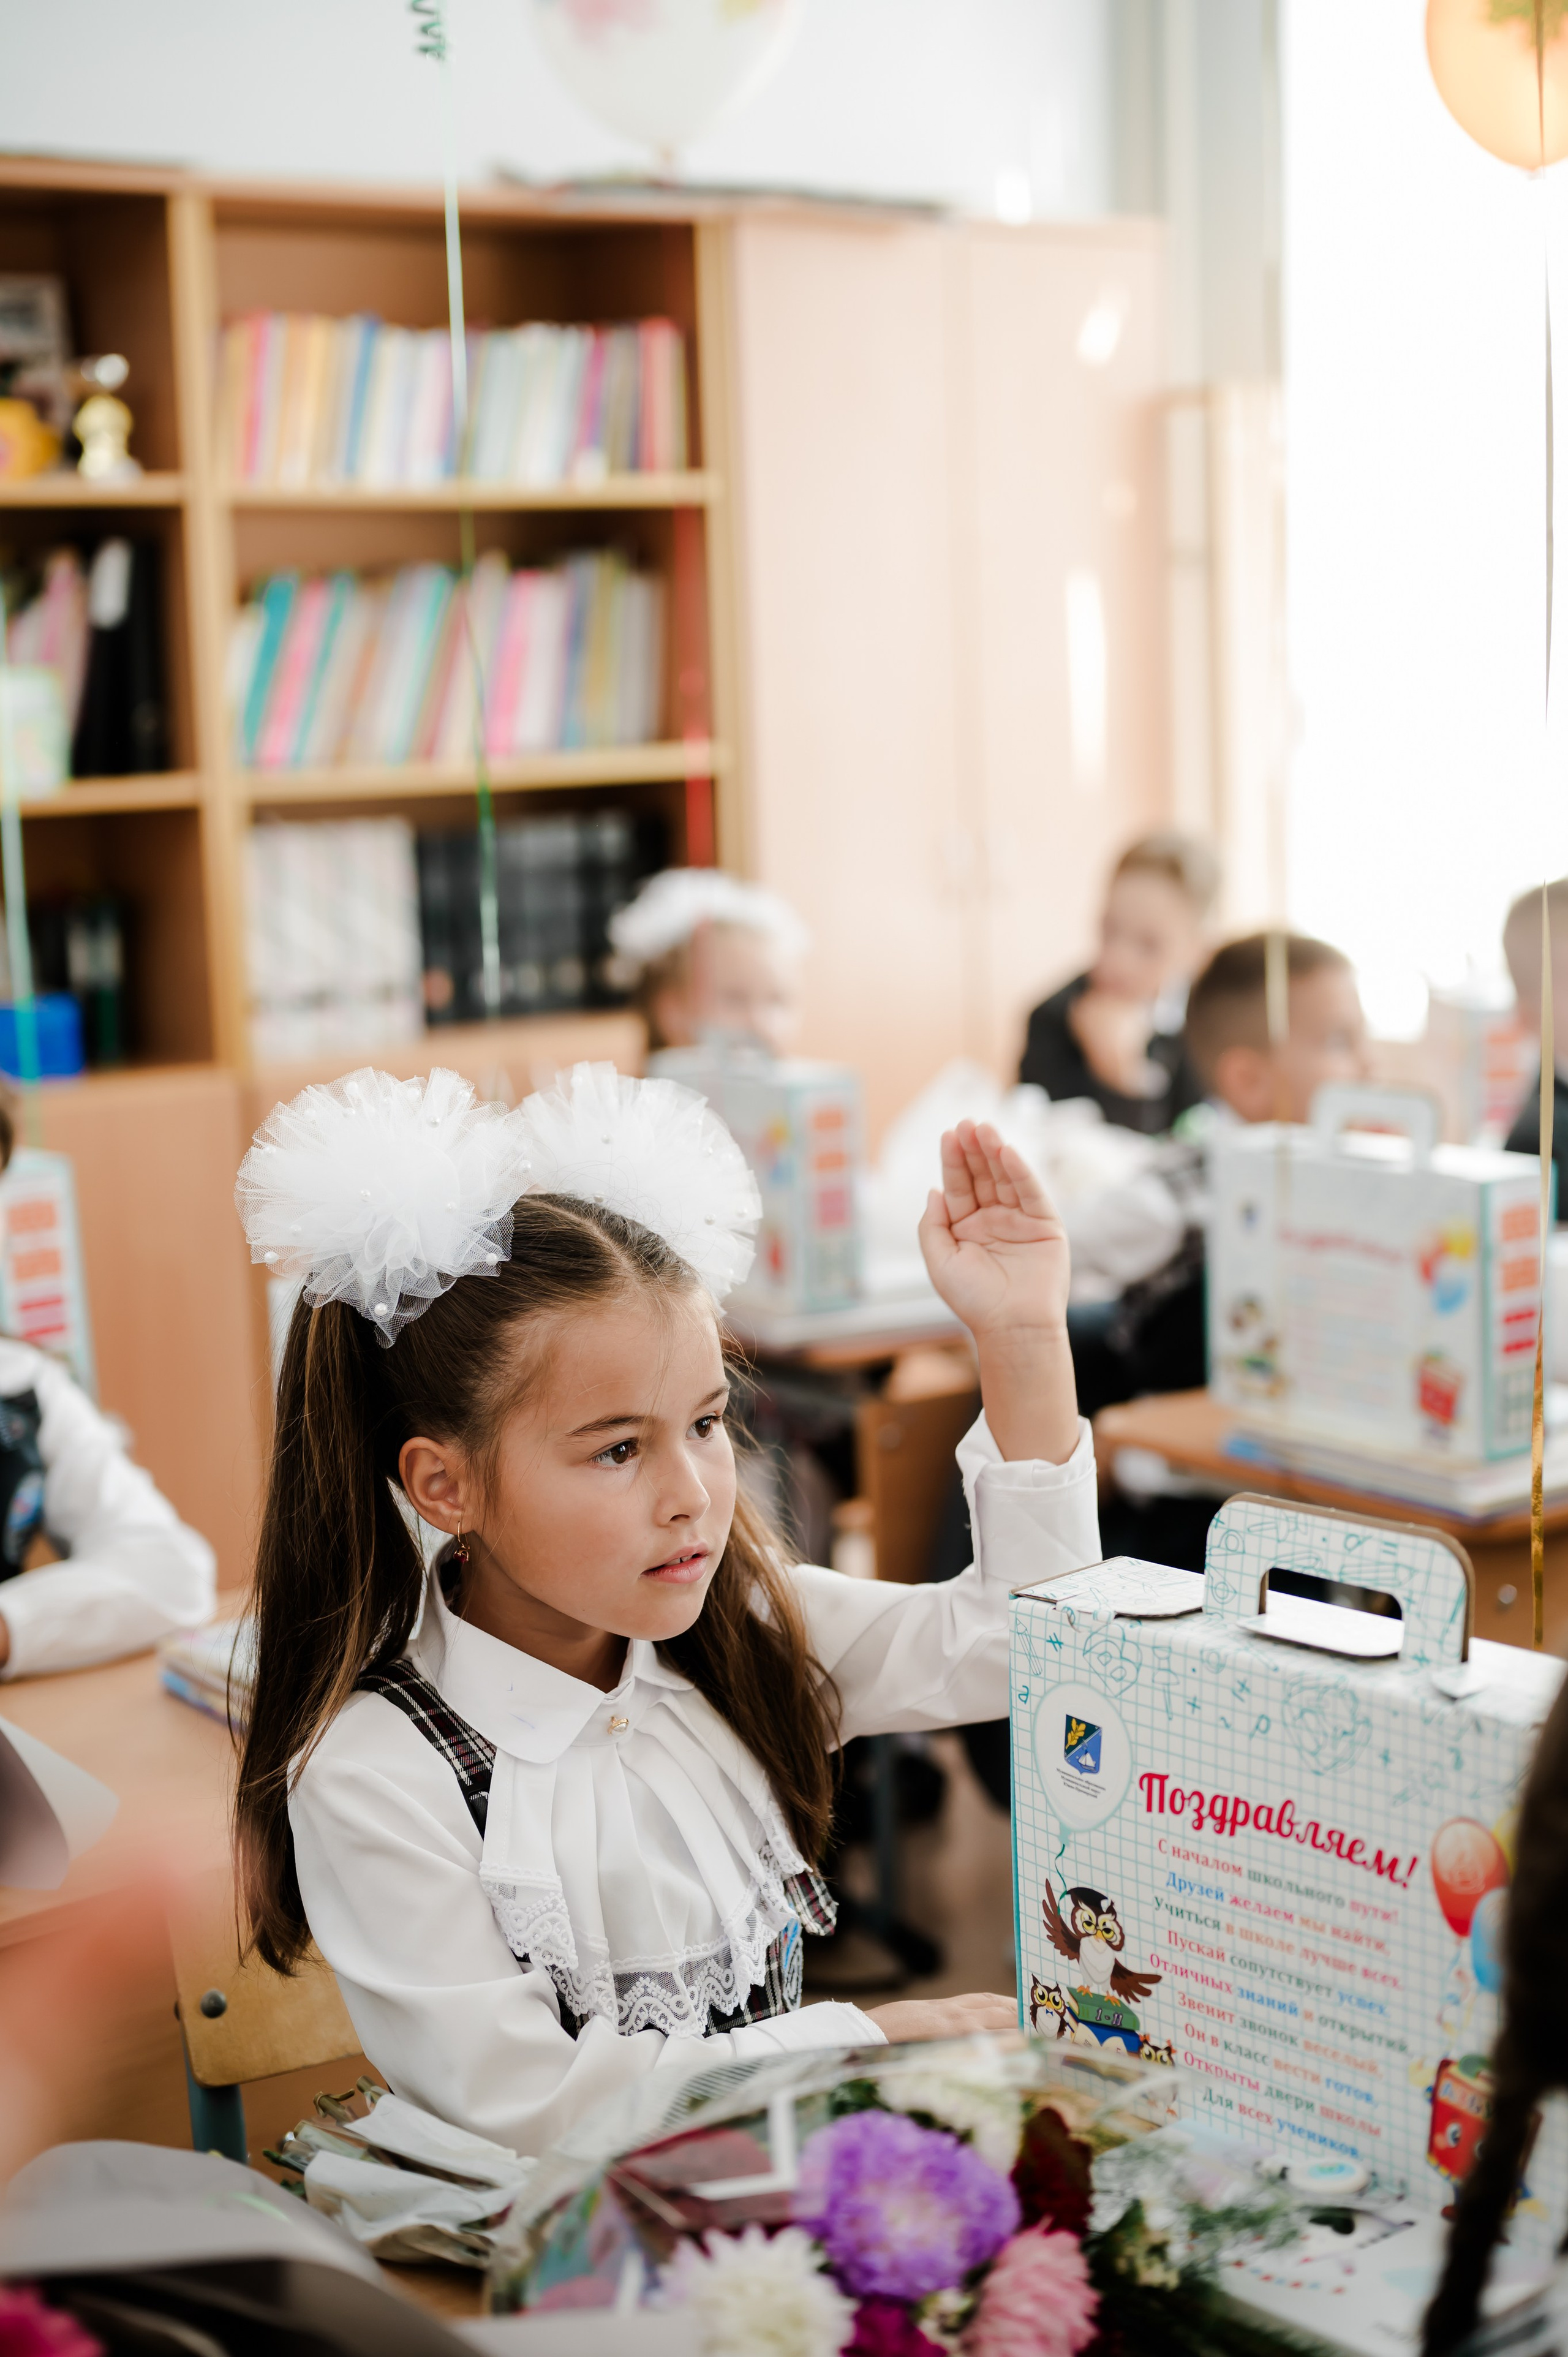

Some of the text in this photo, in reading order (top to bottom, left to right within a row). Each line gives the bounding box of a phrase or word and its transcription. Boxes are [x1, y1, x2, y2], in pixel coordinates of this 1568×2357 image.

[1139, 1773, 1419, 1890] Поздравляем!
[1158, 1838, 1398, 1925] С началом школьного пути!
[1166, 1871, 1224, 1902] Друзей
[1229, 1894, 1294, 1924] желаем
[1299, 1915, 1326, 1933] мы
[1155, 1896, 1221, 1931] Учиться
[1226, 1923, 1235, 1935] в
[1239, 1926, 1295, 1955] школе
[1300, 1947, 1357, 1975] лучше
[1168, 1930, 1225, 1962] Пускай
[1231, 1956, 1332, 1997] сопутствует
[1150, 1953, 1232, 1994] Отличных
[1237, 1987, 1298, 2017] знаний
[1303, 2010, 1314, 2023] и
[1178, 1991, 1235, 2023] Звенит
[1240, 2017, 1298, 2046] звонок
[1185, 2023, 1205, 2042] Он
[1211, 2035, 1219, 2047] в
[1224, 2040, 1269, 2066] класс
[1273, 2058, 1321, 2084] вести
[1184, 2051, 1381, 2138] Открыты двери школы
[1203, 2086, 1233, 2110] Для
[1238, 2103, 1272, 2126] всех
